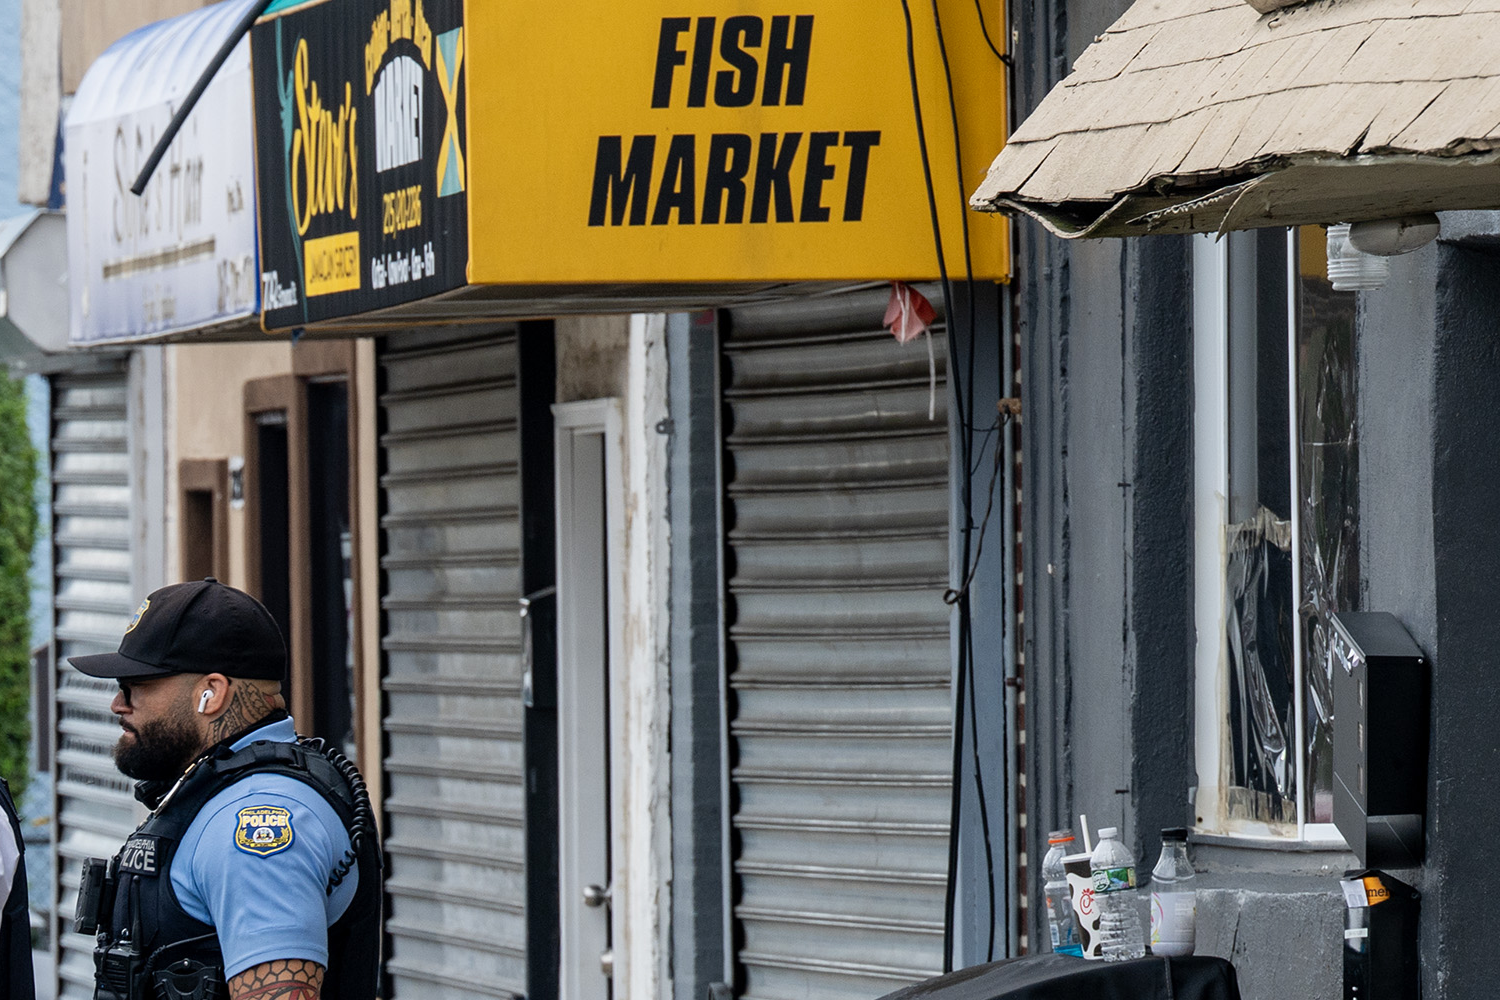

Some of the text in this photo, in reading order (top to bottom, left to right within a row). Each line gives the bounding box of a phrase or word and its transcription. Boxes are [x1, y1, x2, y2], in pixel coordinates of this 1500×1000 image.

[651, 15, 814, 109] FISH
[292, 38, 359, 237] Steve's
[374, 55, 423, 173] MARKET
[588, 130, 881, 227] MARKET
[242, 815, 286, 828] POLICE
